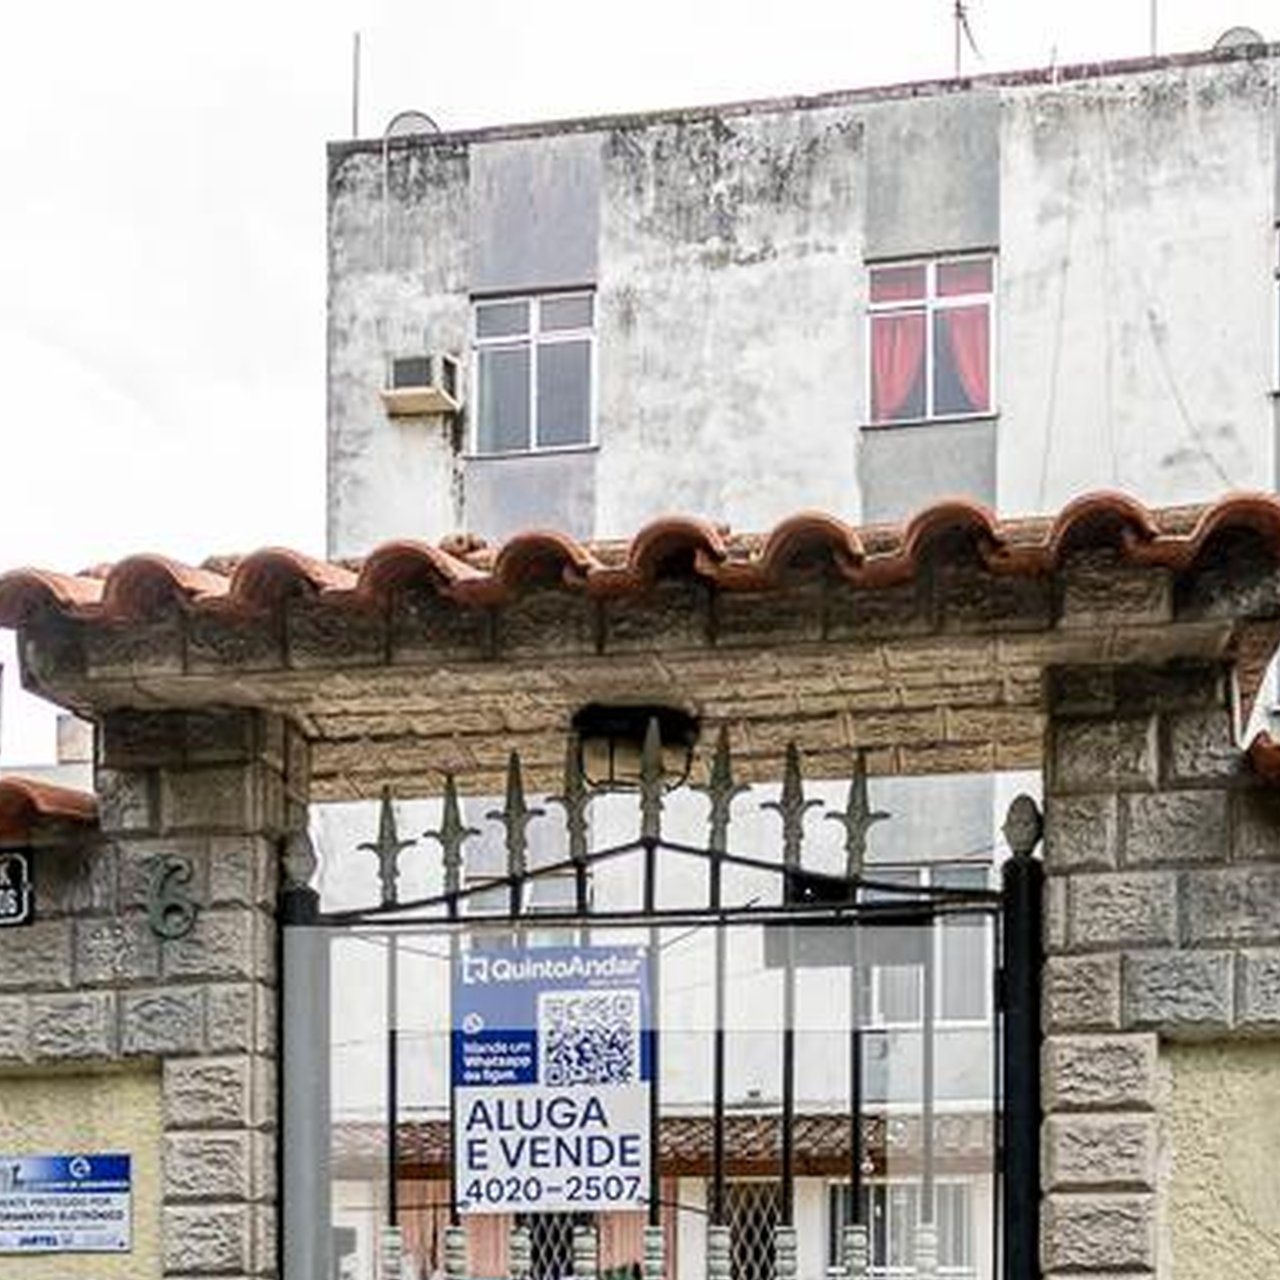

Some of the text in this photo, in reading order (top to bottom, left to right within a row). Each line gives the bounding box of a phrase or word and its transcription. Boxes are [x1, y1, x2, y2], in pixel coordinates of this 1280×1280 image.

[144, 854, 198, 939] 6
[491, 954, 641, 982] QuintoAndar
[466, 1097, 608, 1131] ALUGA
[467, 1135, 641, 1170] E VENDE
[90, 1196, 111, 1206] POR
[465, 1176, 642, 1203] 4020-2507
